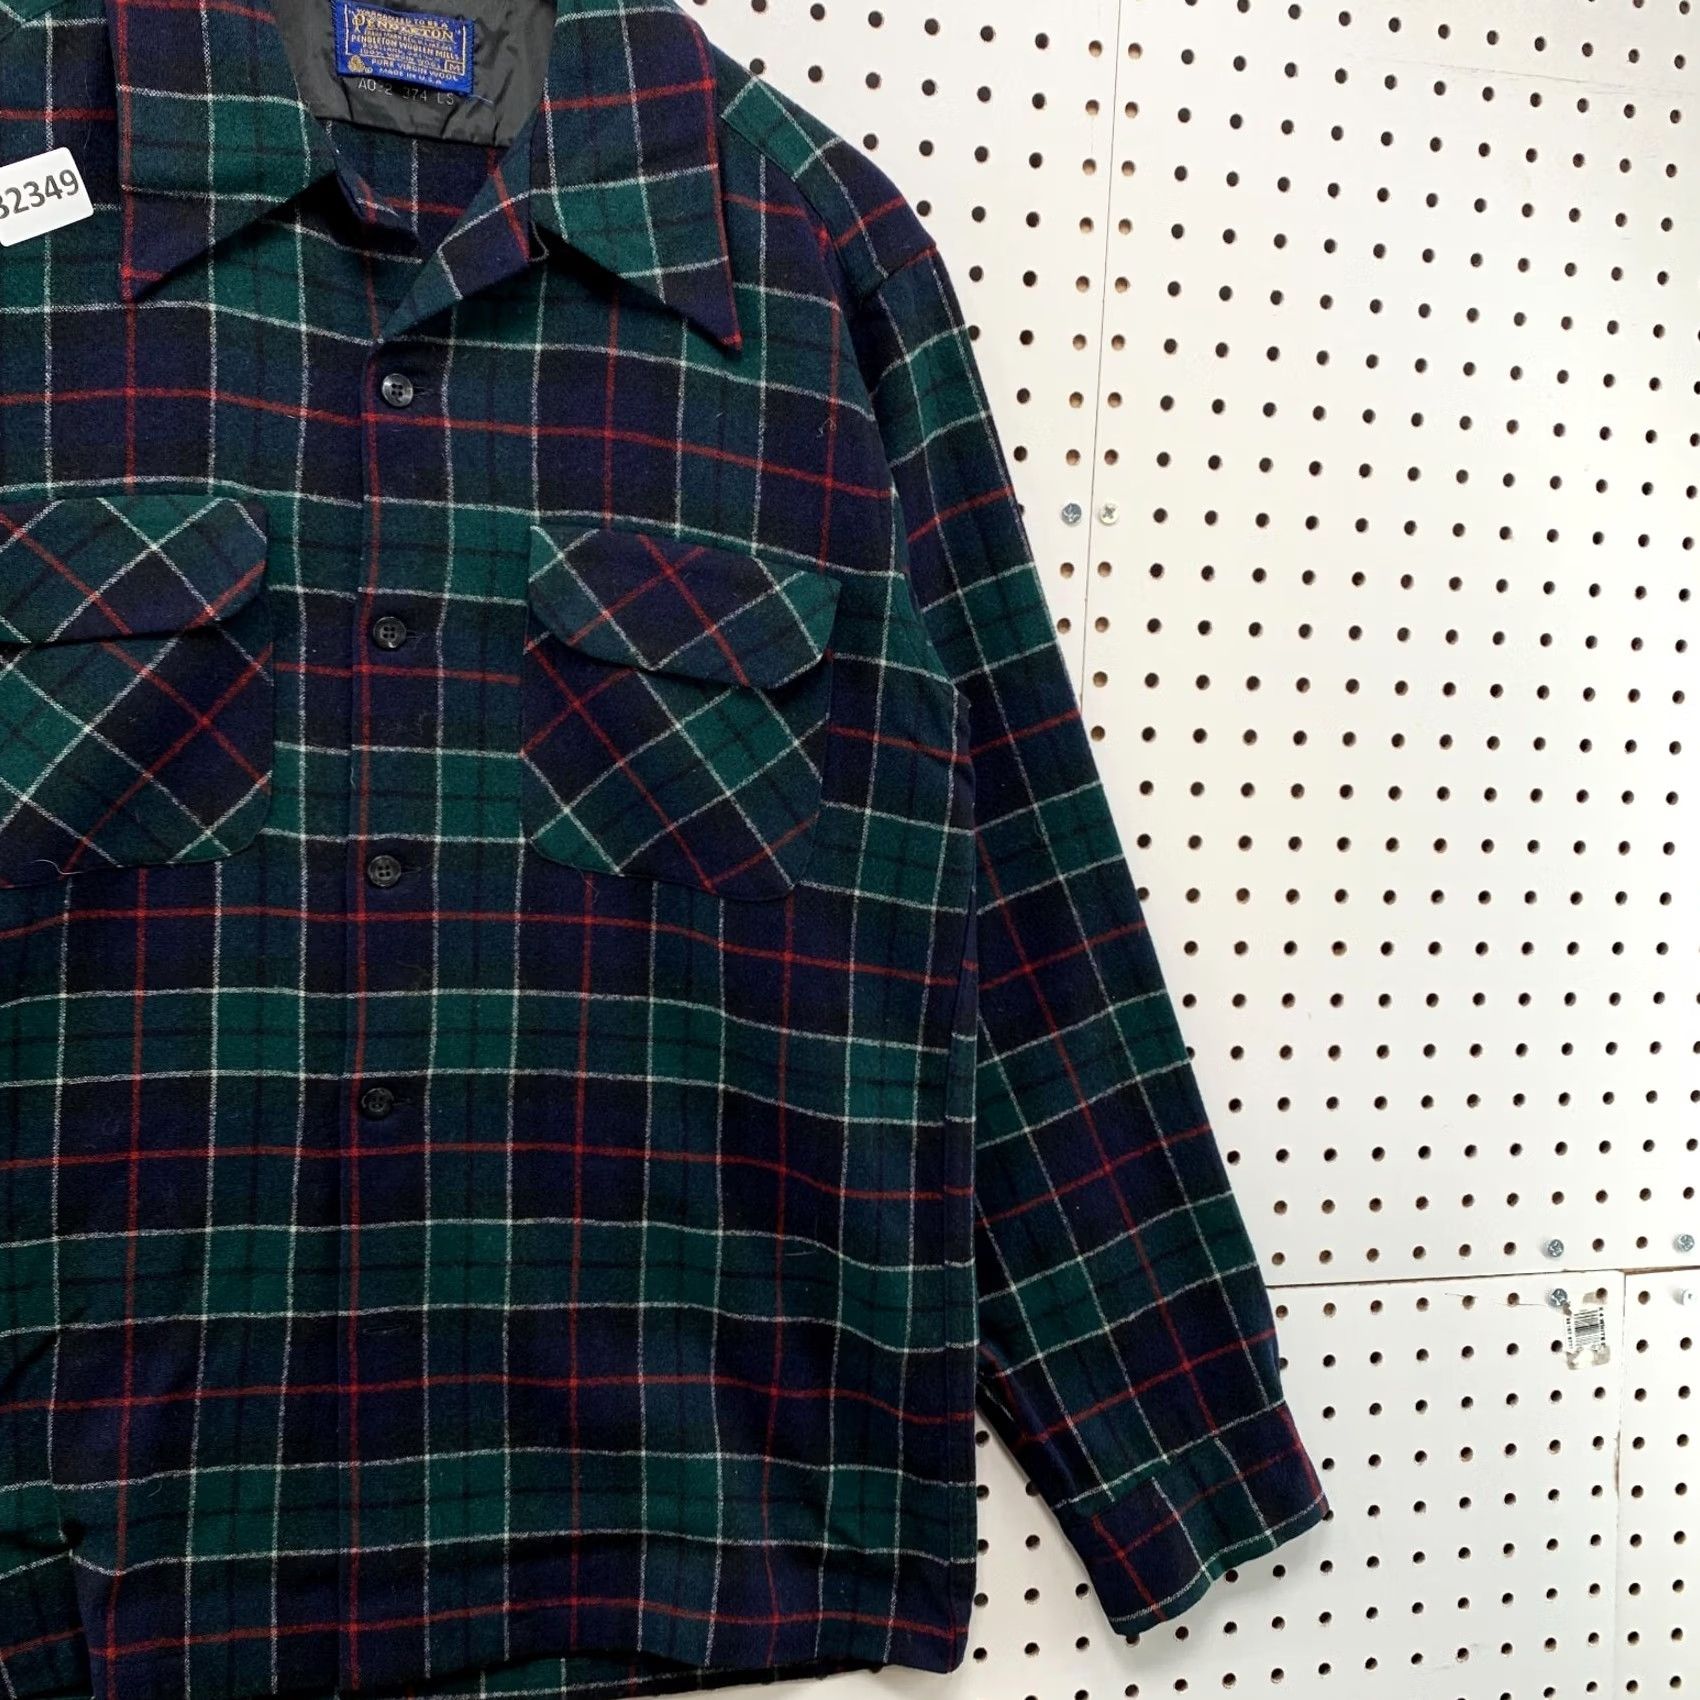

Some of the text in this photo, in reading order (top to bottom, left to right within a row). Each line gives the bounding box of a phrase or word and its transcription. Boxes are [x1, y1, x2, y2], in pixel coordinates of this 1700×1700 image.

[351, 11, 454, 41] PENDLETON
[351, 34, 398, 46] PENDLETON
[435, 50, 460, 60] MILLS
[372, 59, 395, 68] PURE
[429, 70, 460, 81] WOOL
[379, 68, 404, 77] MADE
[406, 71, 418, 79] IN
[449, 63, 460, 71] M
